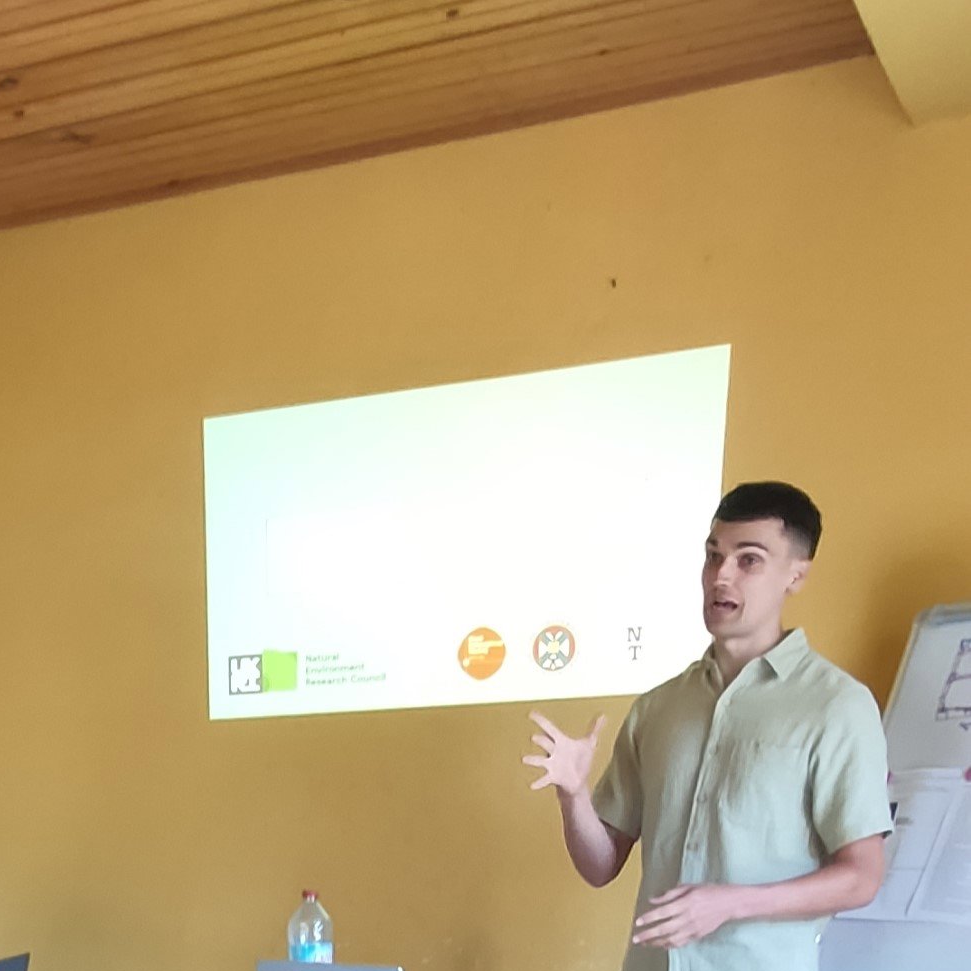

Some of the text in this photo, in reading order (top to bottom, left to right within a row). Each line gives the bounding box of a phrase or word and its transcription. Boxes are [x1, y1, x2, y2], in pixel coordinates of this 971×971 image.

[627, 627, 642, 642] N
[306, 652, 339, 663] Natural
[628, 645, 642, 661] T
[306, 663, 365, 675] Environment
[306, 673, 387, 686] Research Council
